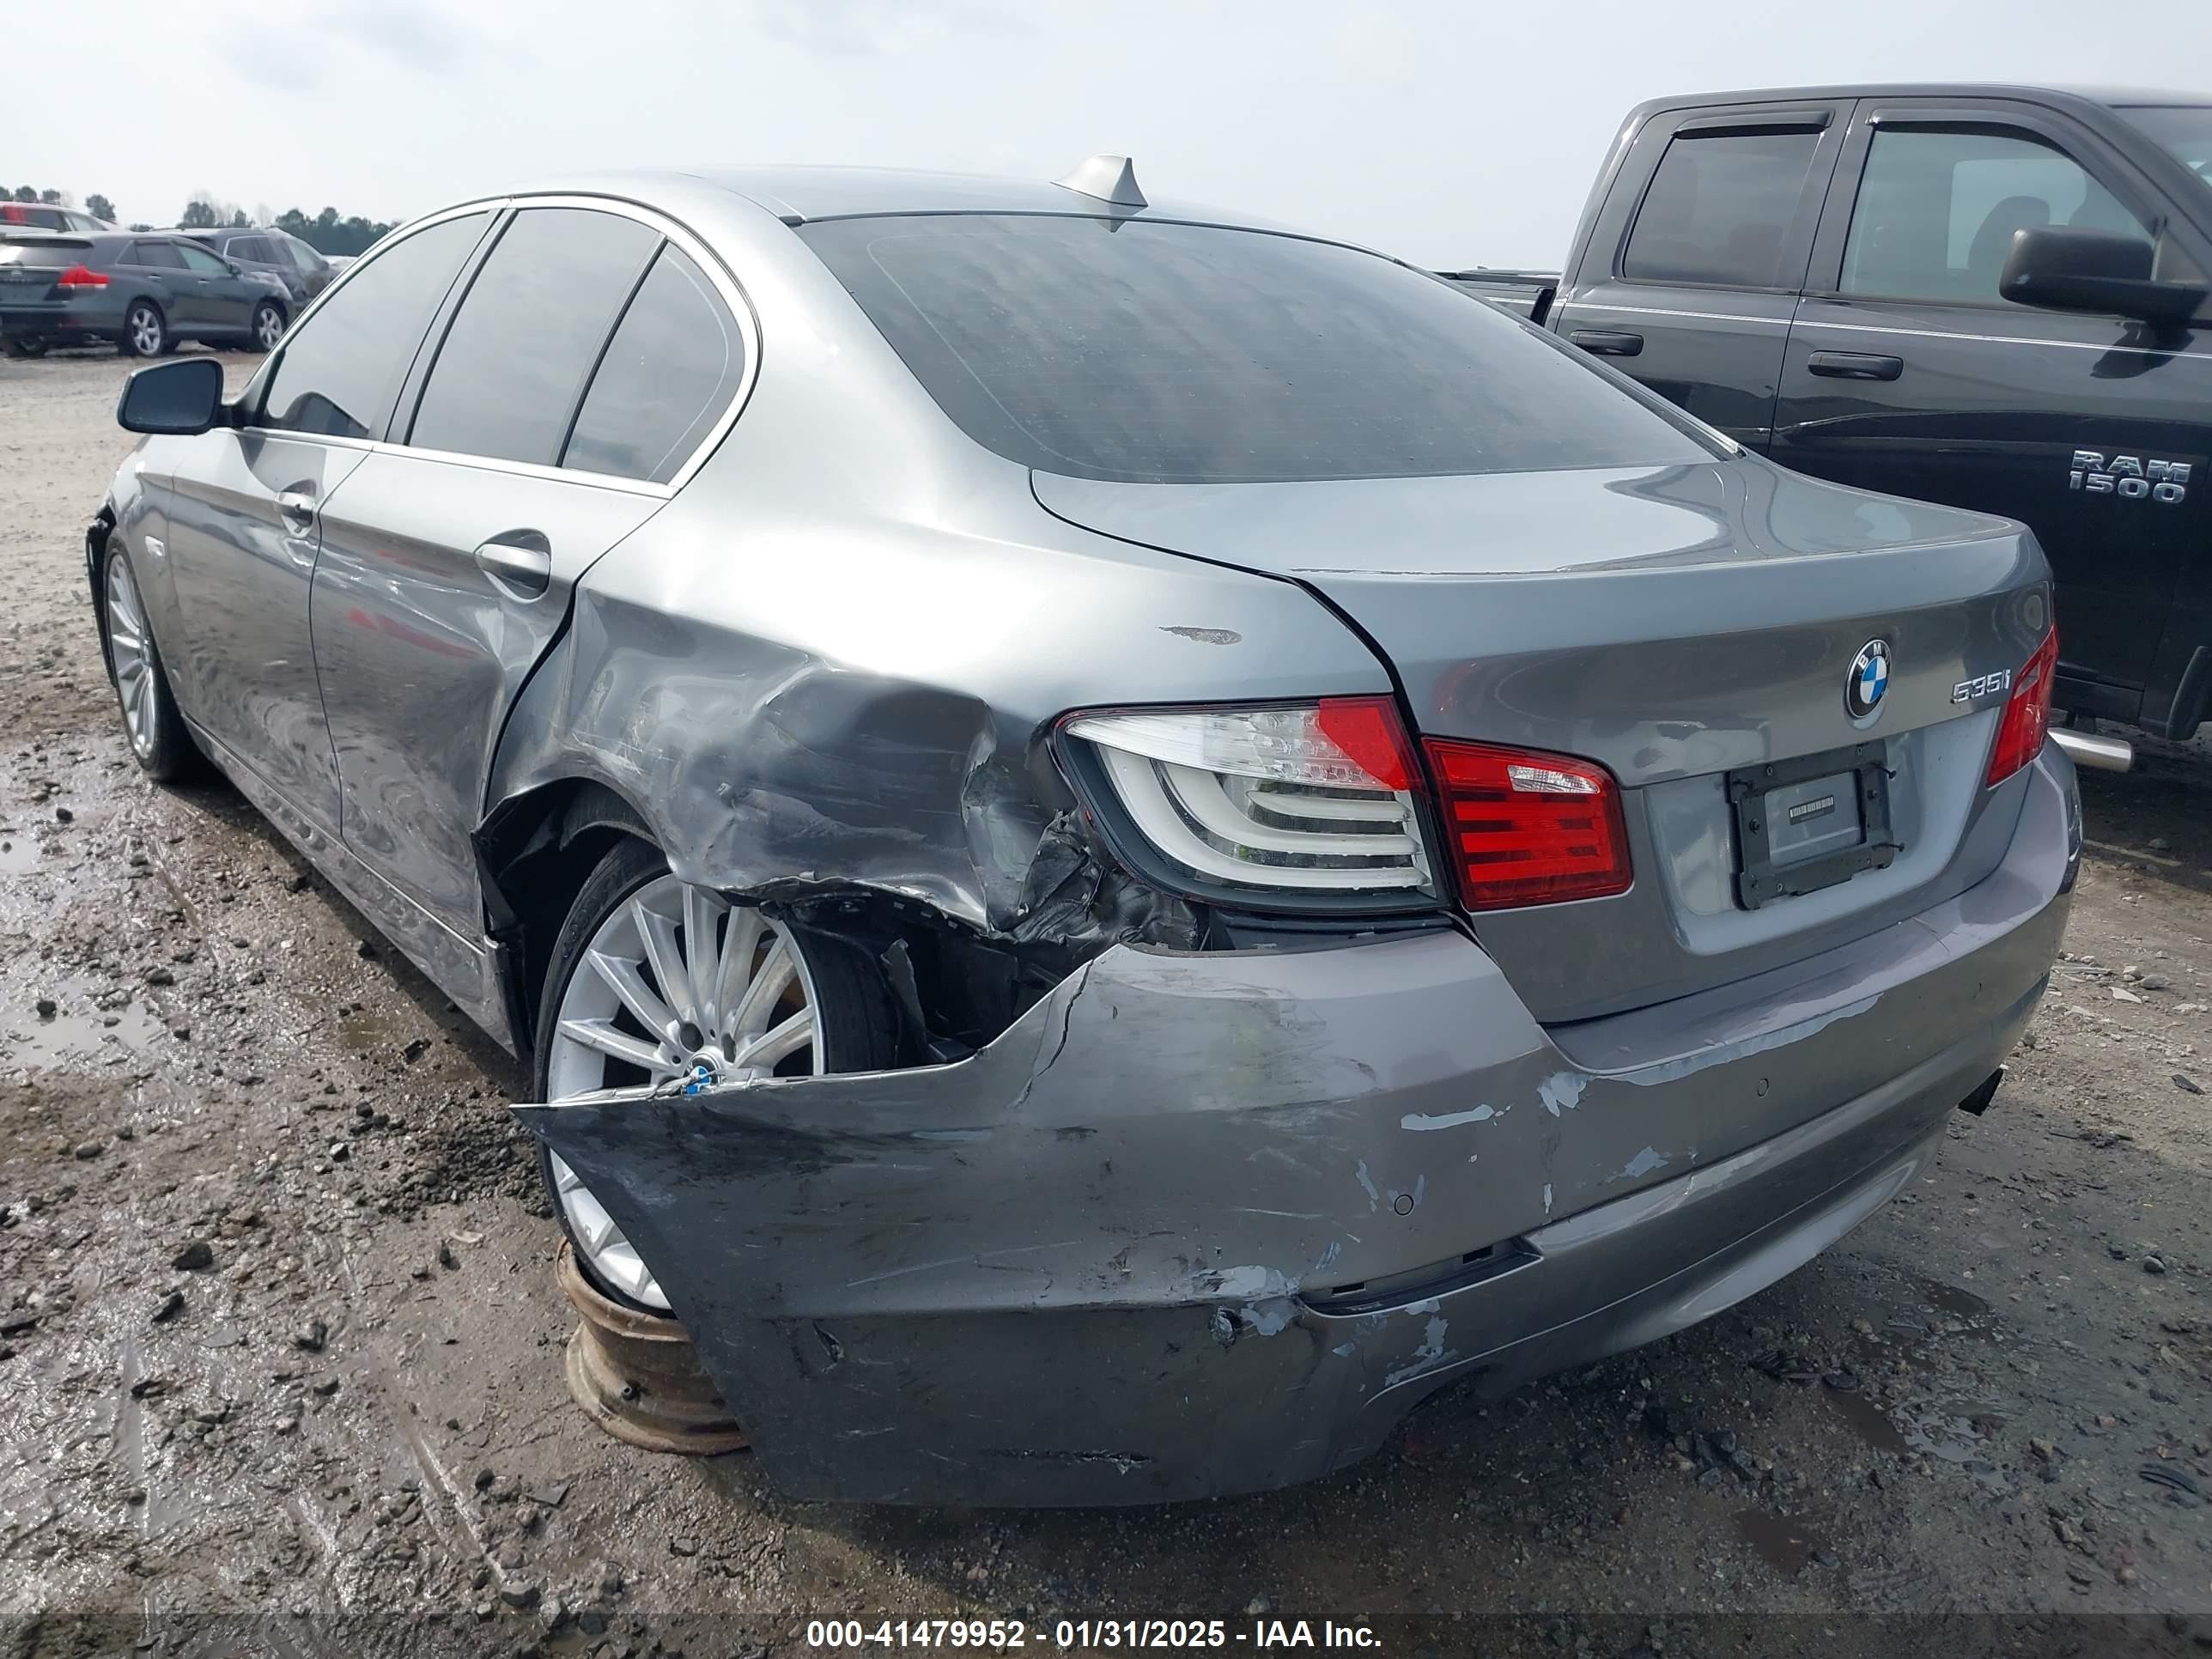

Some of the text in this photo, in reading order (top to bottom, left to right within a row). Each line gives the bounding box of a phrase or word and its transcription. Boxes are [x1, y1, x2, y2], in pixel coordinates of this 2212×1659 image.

[2071, 450, 2191, 483] RAM
[2069, 471, 2185, 504] 1500
[1857, 642, 1891, 670] BMW
[1953, 669, 2011, 702] 535i
